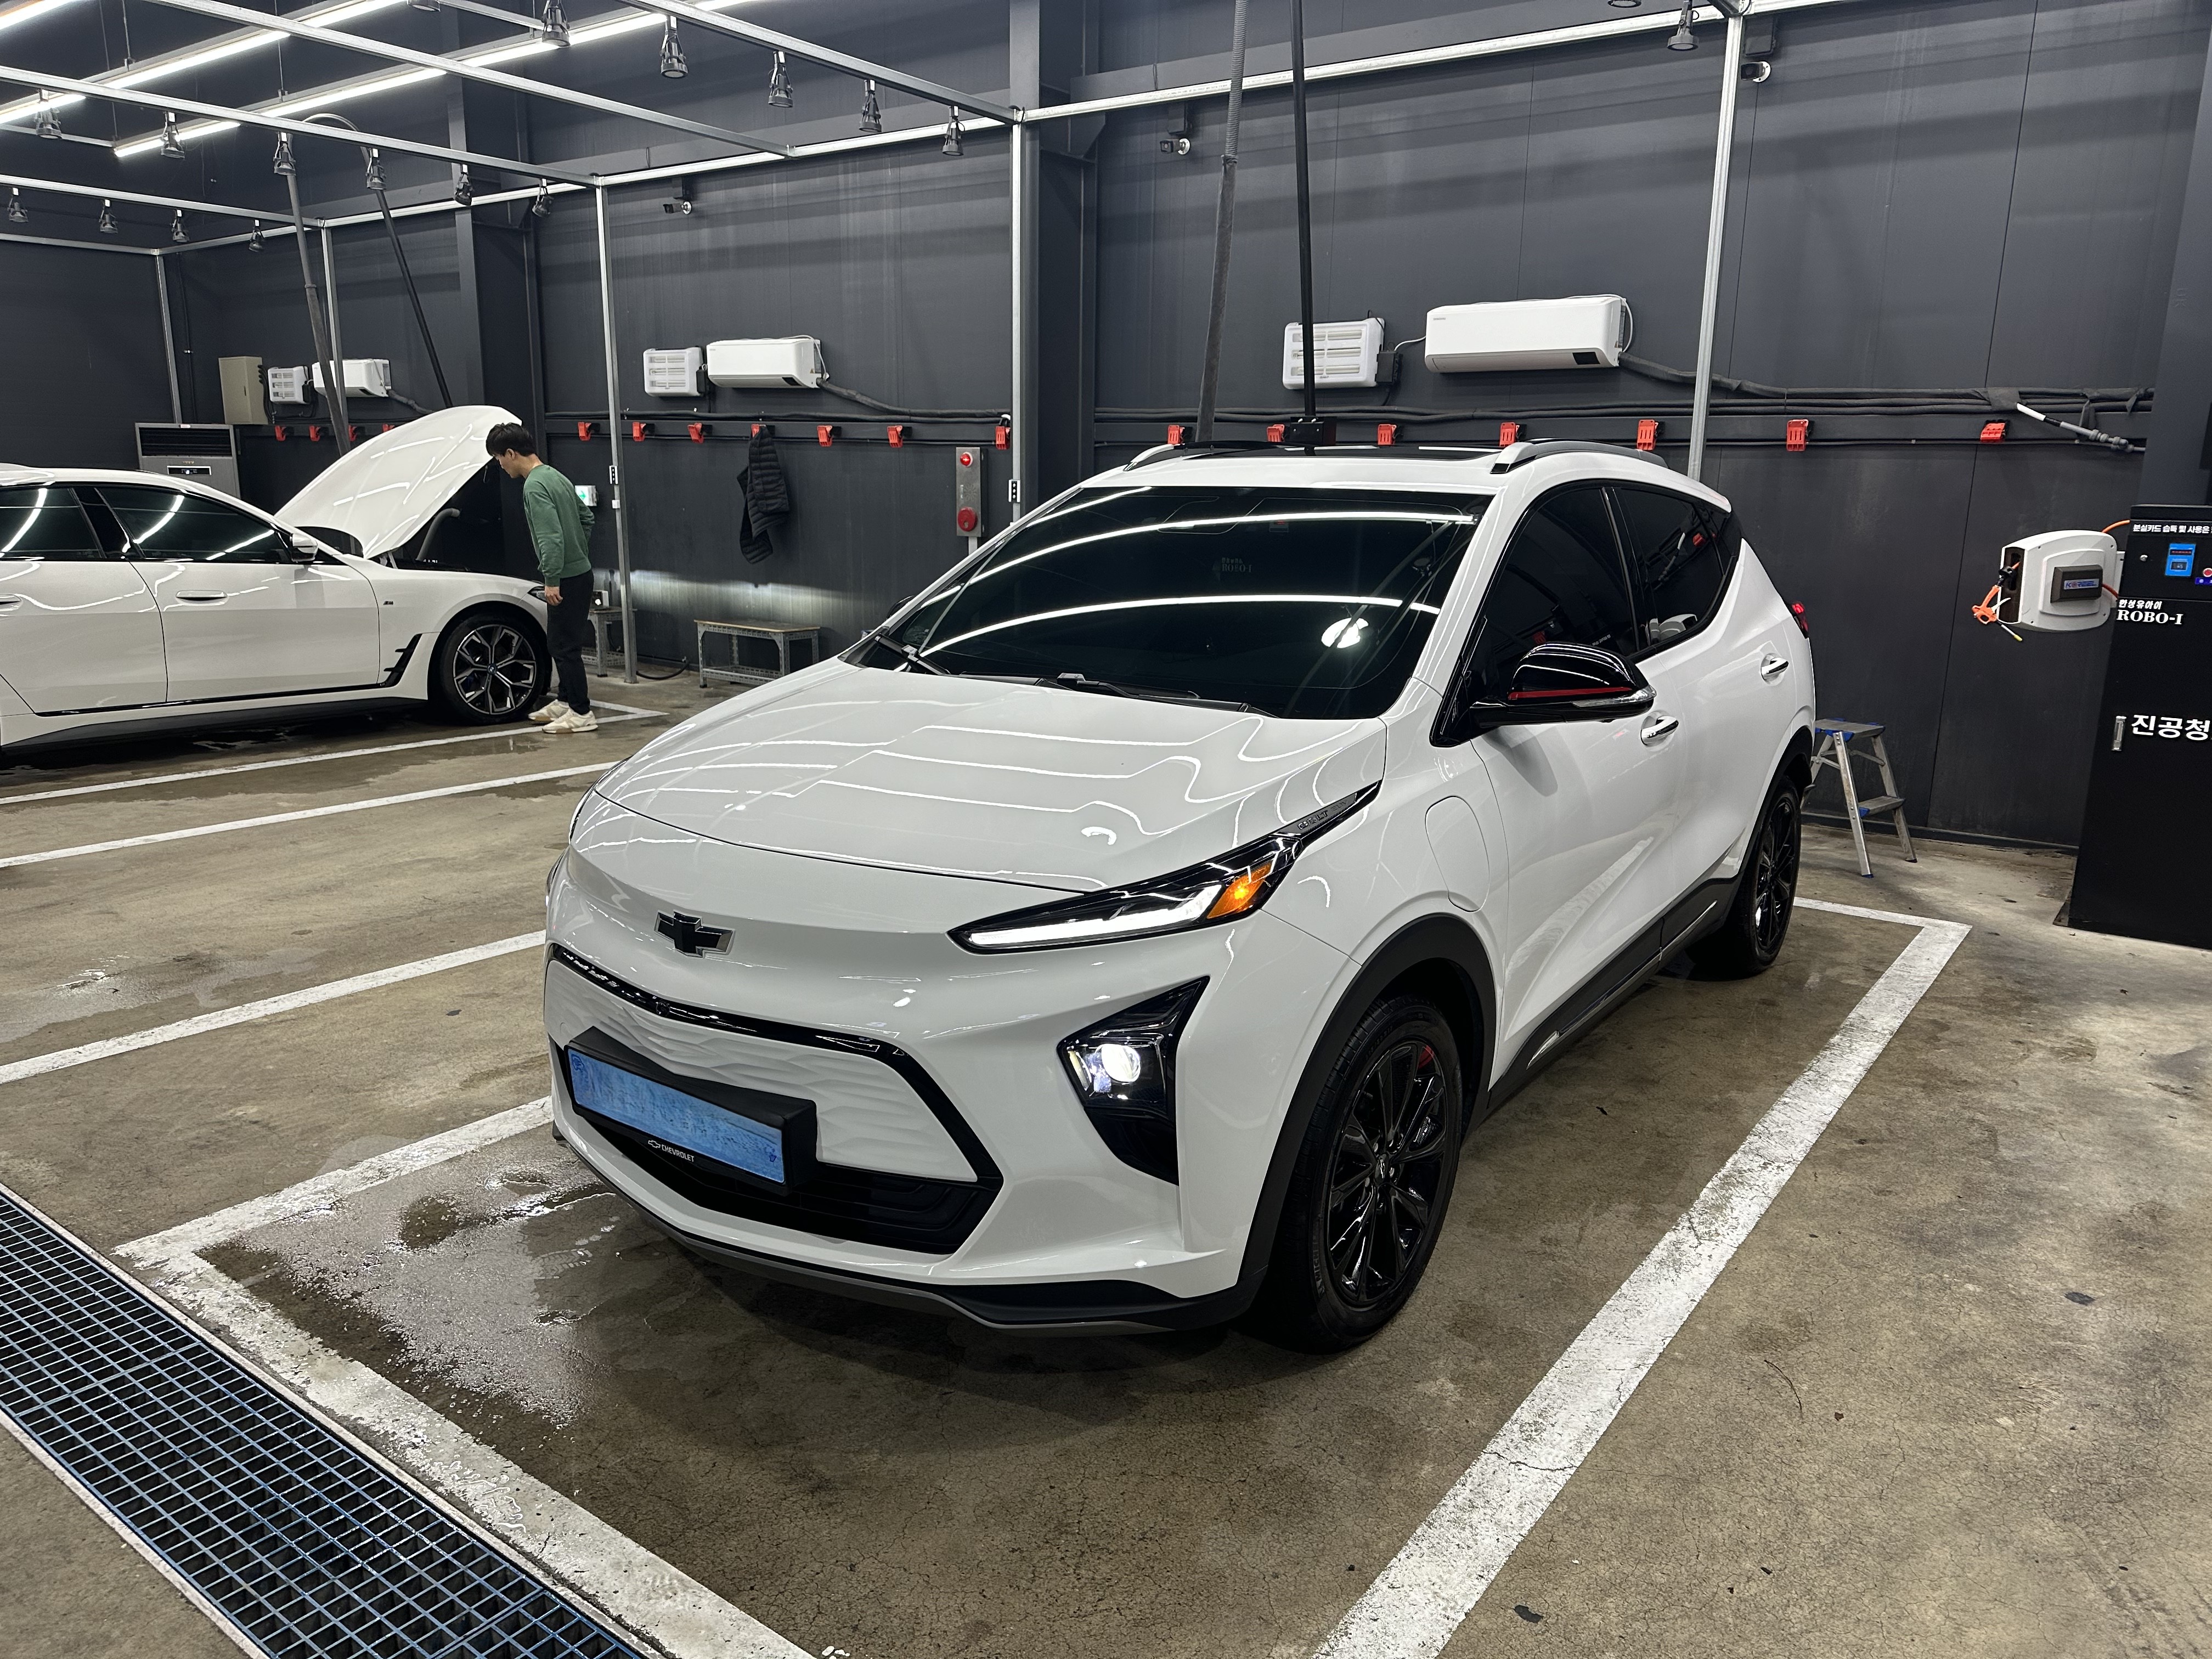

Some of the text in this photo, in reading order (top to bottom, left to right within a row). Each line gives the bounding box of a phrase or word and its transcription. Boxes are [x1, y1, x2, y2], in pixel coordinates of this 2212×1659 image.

[2187, 526, 2210, 534] 사용은
[2117, 610, 2183, 625] ROBO-I
[2131, 714, 2212, 741] 진공청
[661, 1144, 695, 1163] CHEVROLET
